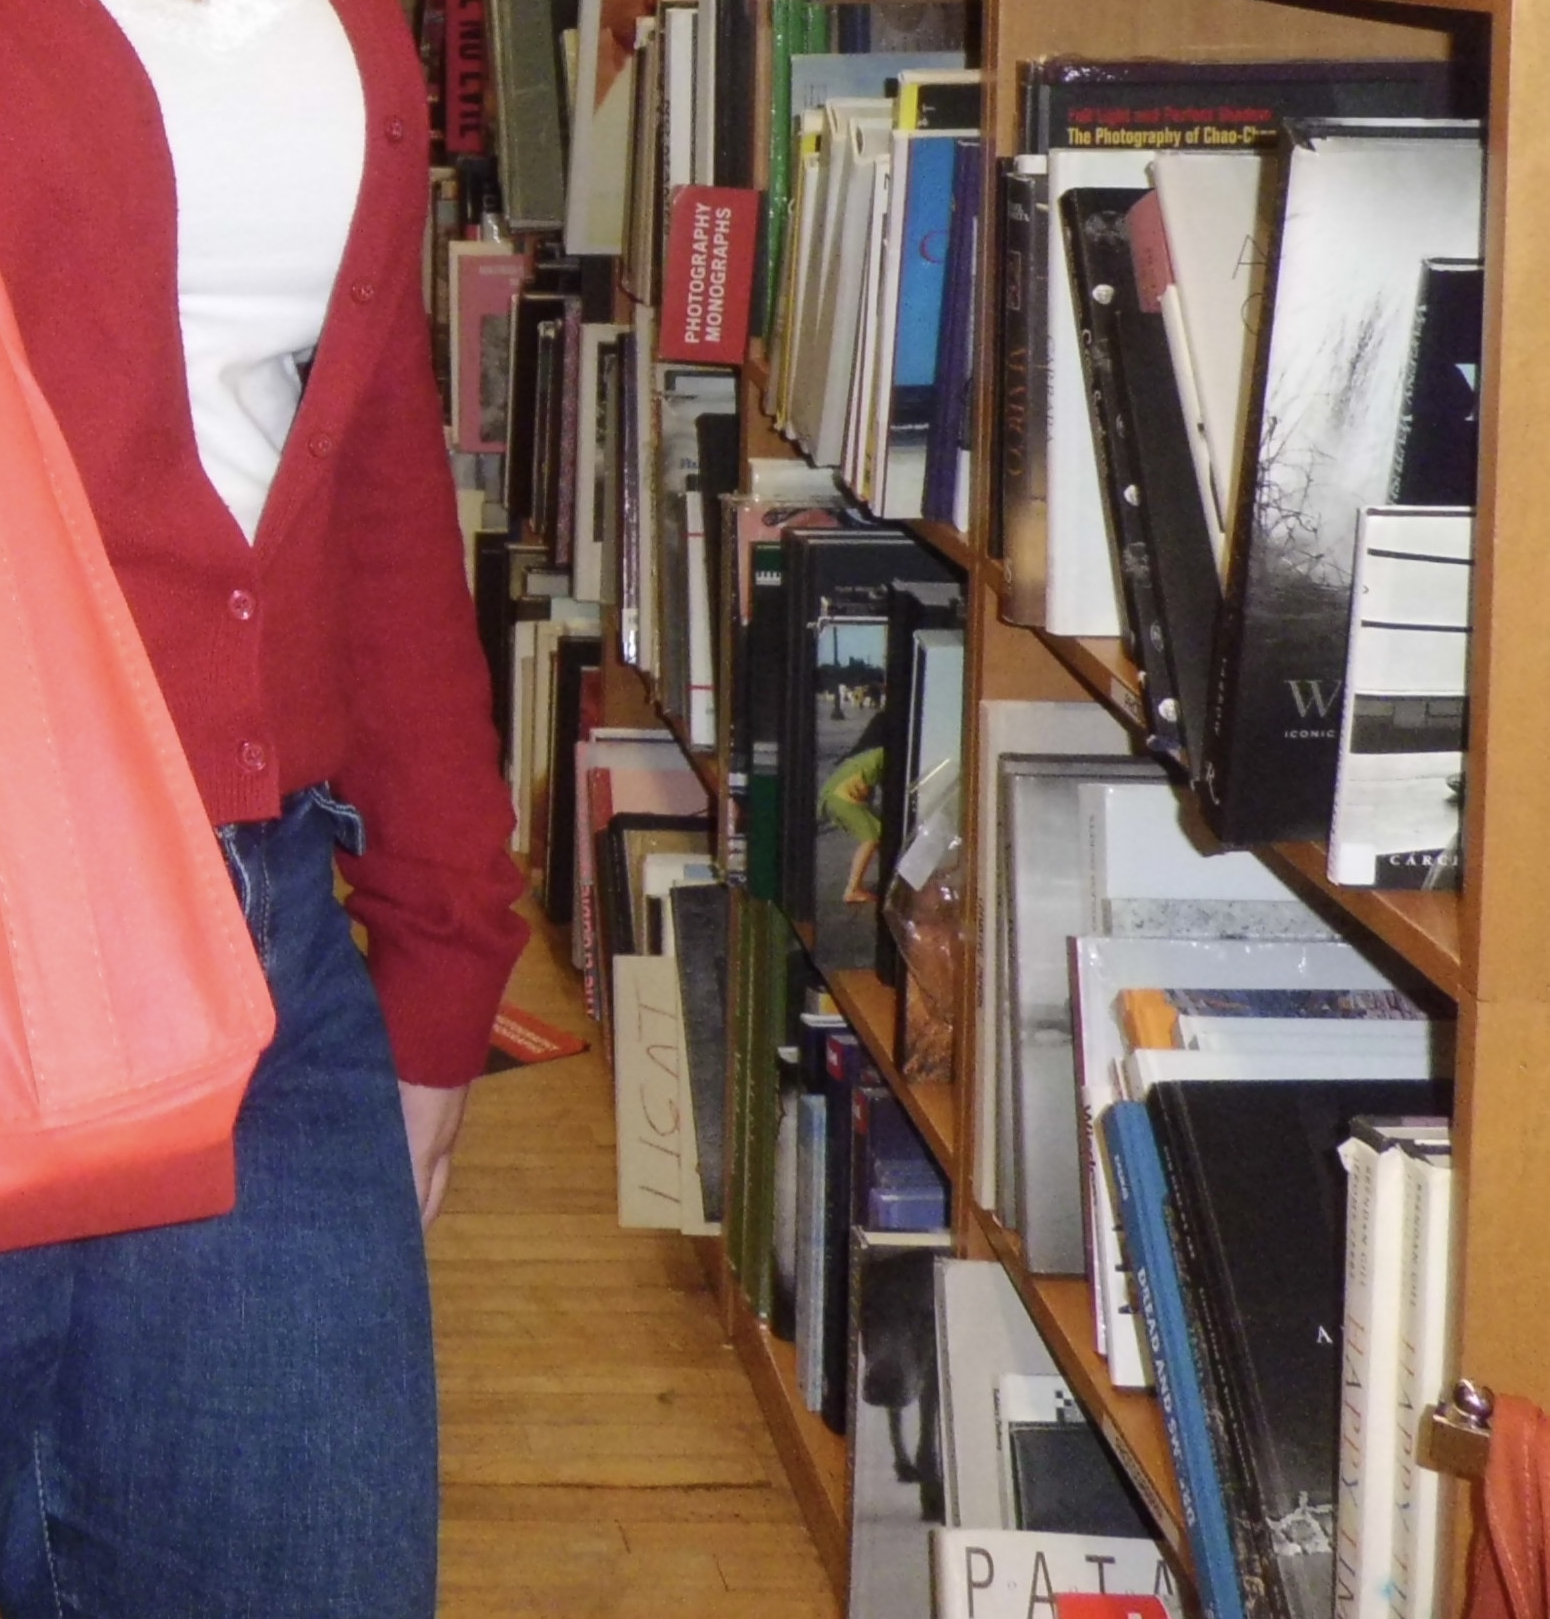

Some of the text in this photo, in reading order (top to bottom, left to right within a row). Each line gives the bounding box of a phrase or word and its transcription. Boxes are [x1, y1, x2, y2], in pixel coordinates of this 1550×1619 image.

[1067, 127, 1091, 145] The
[1095, 127, 1183, 147] Photography
[1185, 127, 1200, 145] of
[684, 203, 711, 343] PHOTOGRAPHY
[706, 207, 732, 342] MONOGRAPHS
[1285, 729, 1336, 739] ICONIC
[1154, 1359, 1173, 1413] AND
[1342, 1315, 1366, 1507] HAPPY
